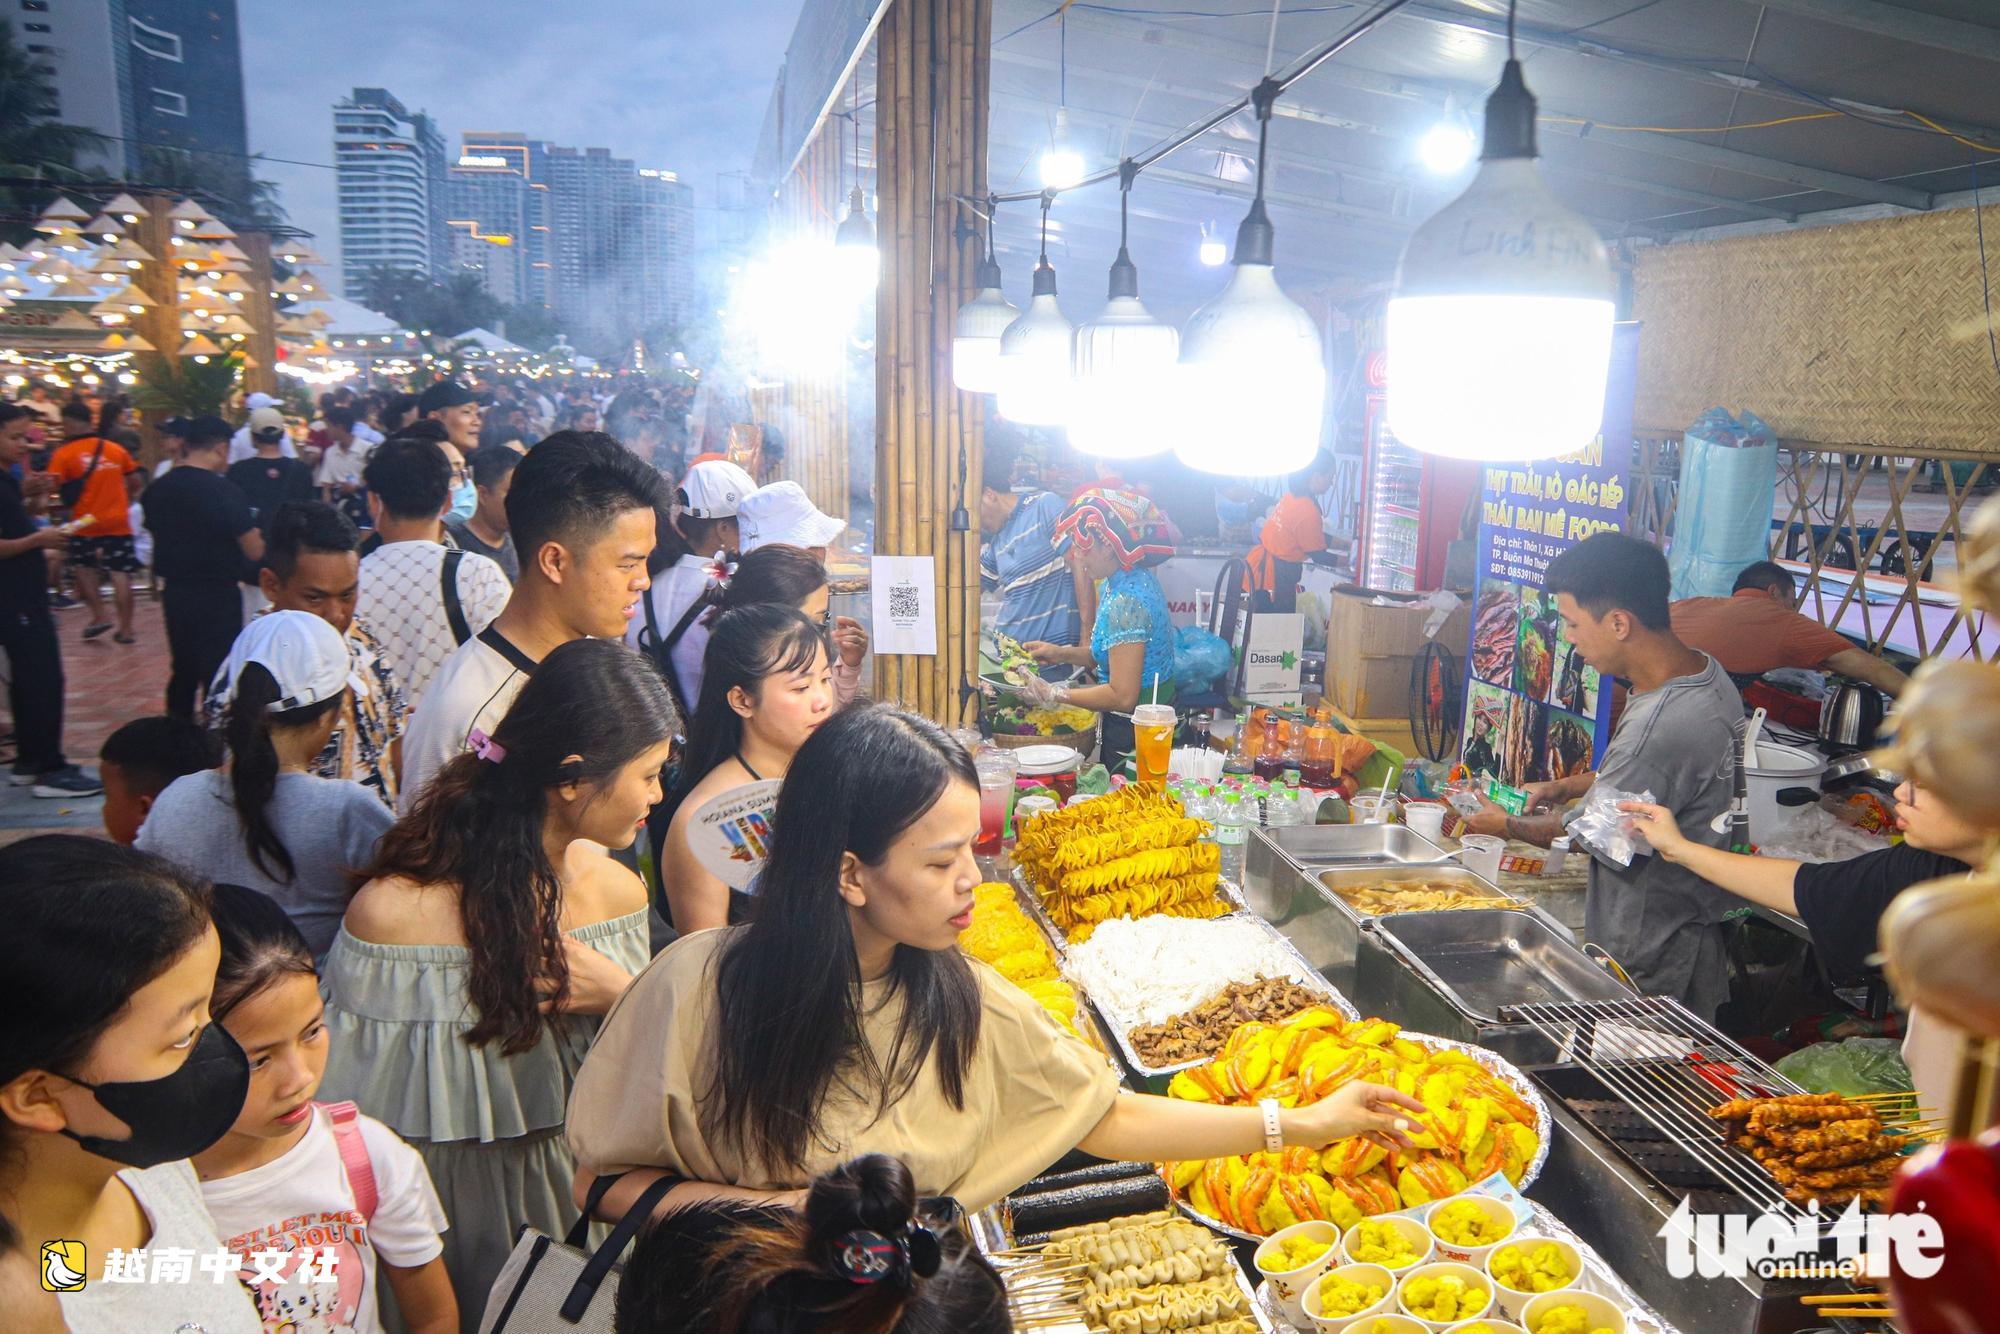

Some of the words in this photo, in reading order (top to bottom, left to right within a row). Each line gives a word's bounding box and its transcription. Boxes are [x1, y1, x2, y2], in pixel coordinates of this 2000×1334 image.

[1545, 470, 1563, 501] BÒ
[1565, 473, 1598, 506] GÁC
[1483, 498, 1514, 528] THÁI
[1515, 506, 1543, 534] BAN
[1543, 507, 1567, 539] MÊ
[1493, 535, 1506, 548] Địa
[1544, 545, 1554, 557] Xã
[1168, 601, 1210, 612] NAKY
[267, 1213, 316, 1237] LET
[320, 1210, 363, 1225] ME
[290, 1225, 346, 1249] YOU
